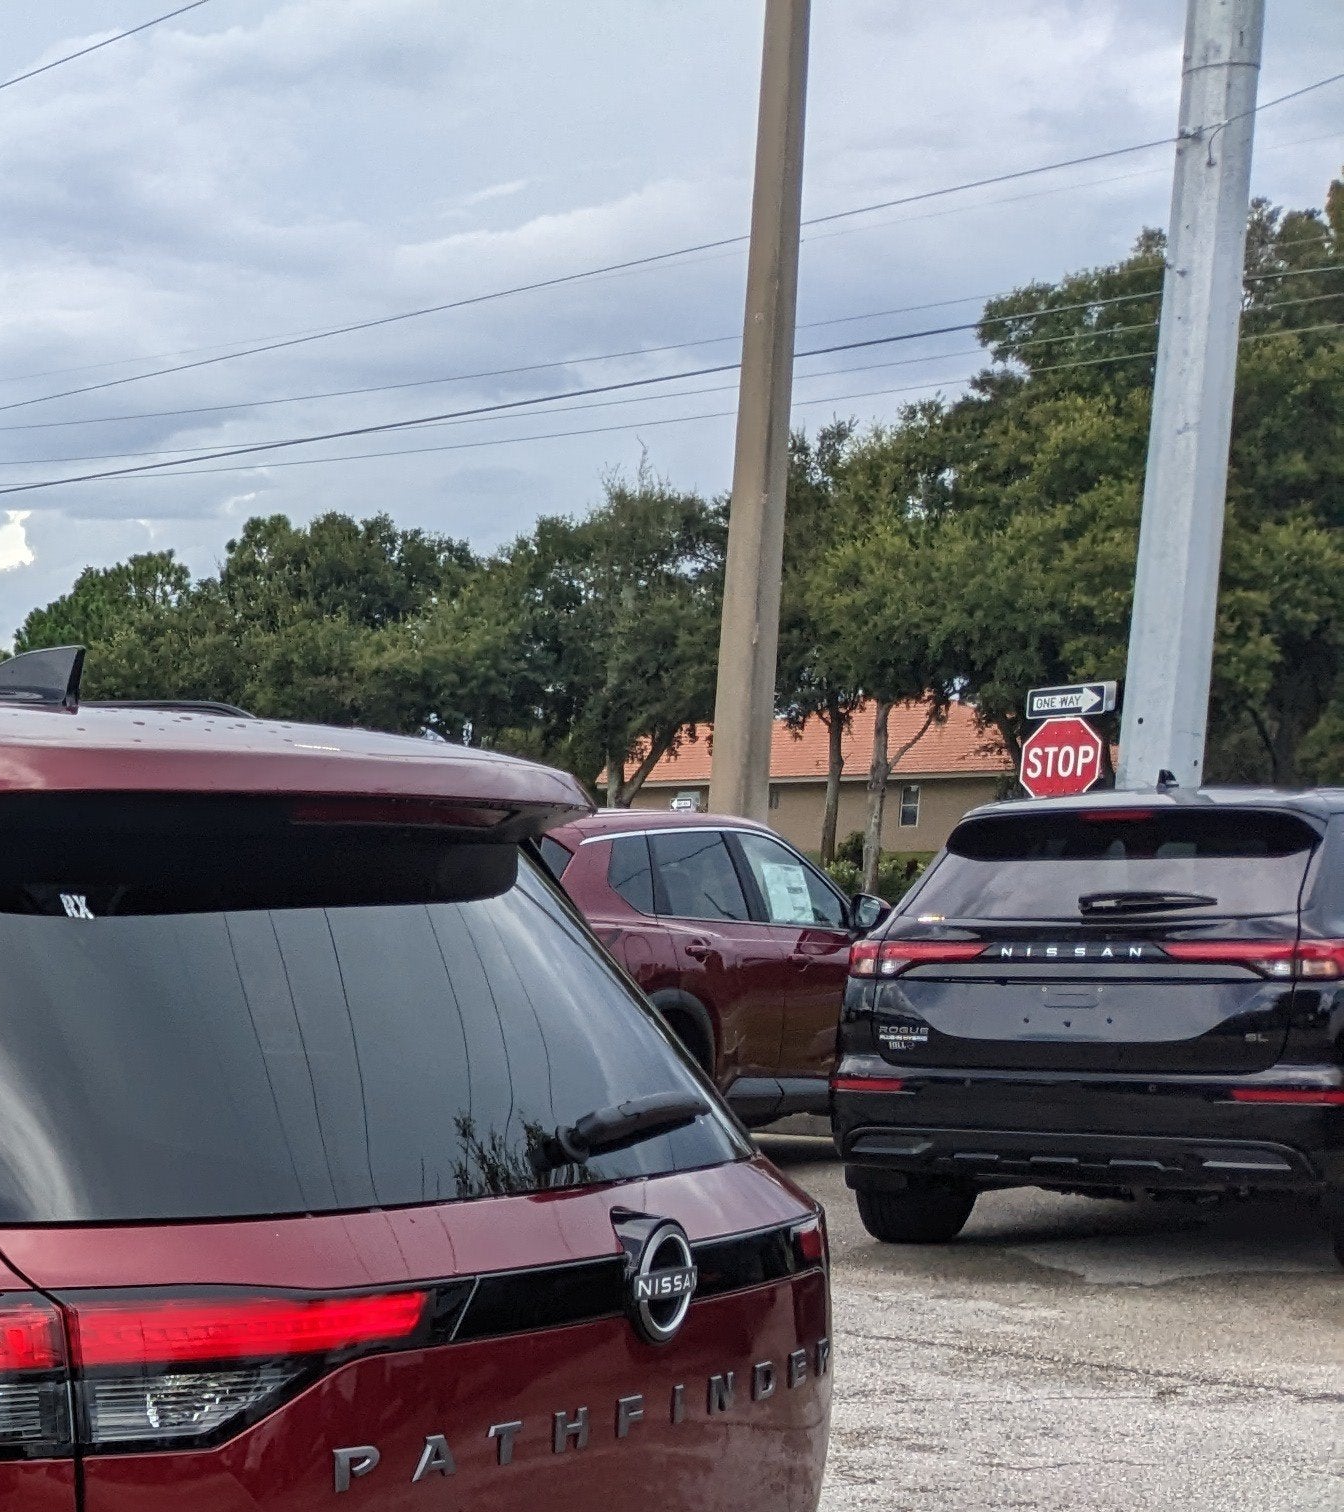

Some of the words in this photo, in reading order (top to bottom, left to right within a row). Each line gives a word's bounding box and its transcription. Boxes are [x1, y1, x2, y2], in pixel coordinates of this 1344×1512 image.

[1035, 697, 1057, 709] ONE
[1058, 695, 1081, 707] WAY
[1026, 745, 1095, 779] STOP
[1000, 946, 1143, 957] NISSAN
[878, 1025, 929, 1035] ROGUE
[637, 1271, 697, 1298] NISSAN
[333, 1338, 830, 1493] PATHFINDER
